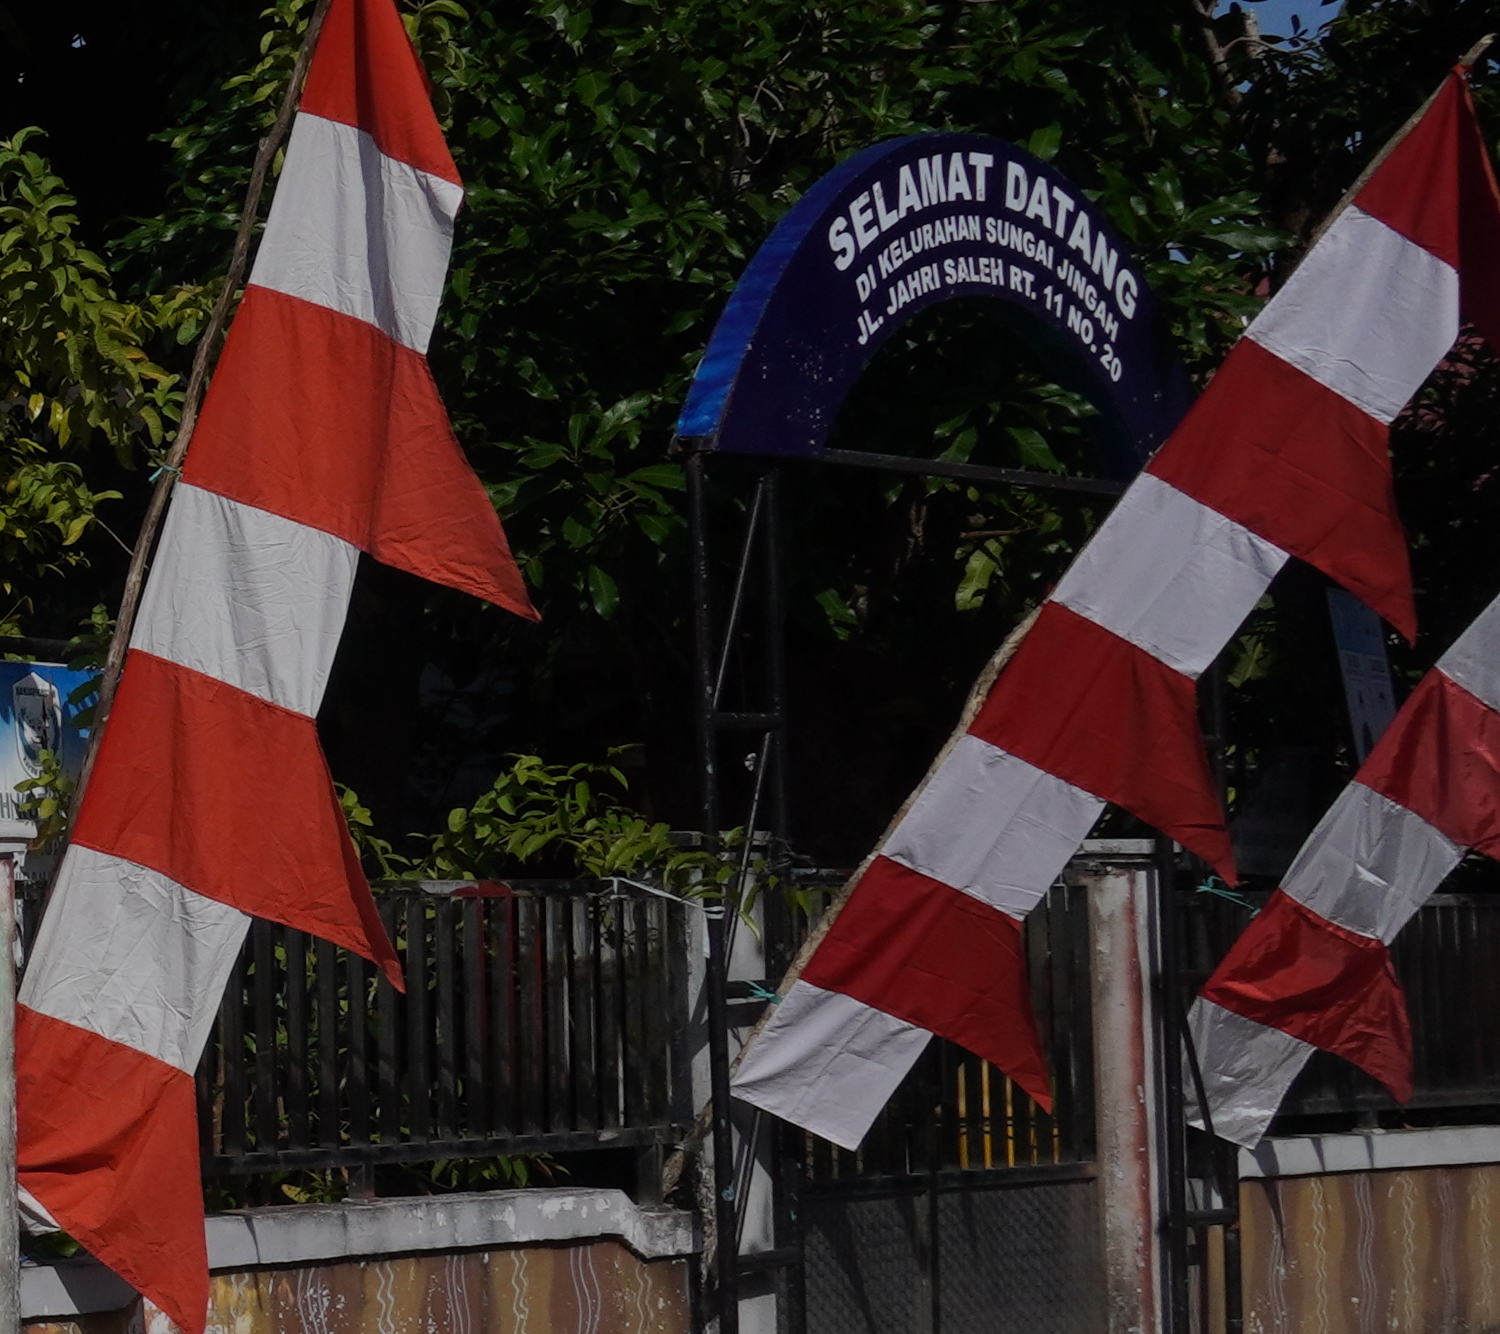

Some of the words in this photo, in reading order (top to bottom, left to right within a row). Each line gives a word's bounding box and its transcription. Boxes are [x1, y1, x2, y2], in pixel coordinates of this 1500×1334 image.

[828, 151, 994, 272] SELAMAT
[1004, 160, 1139, 320] DATANG
[854, 264, 877, 303] DI
[878, 215, 981, 280] KELURAHAN
[985, 217, 1054, 270] SUNGAI
[1056, 258, 1119, 343] JINGAH
[857, 309, 885, 346] JL.
[886, 263, 942, 316] JAHRI
[943, 256, 1005, 287] SALEH
[1009, 264, 1037, 300] RT.
[1043, 285, 1063, 318] 11
[1068, 305, 1097, 353] NO.
[1100, 343, 1122, 383] 20
